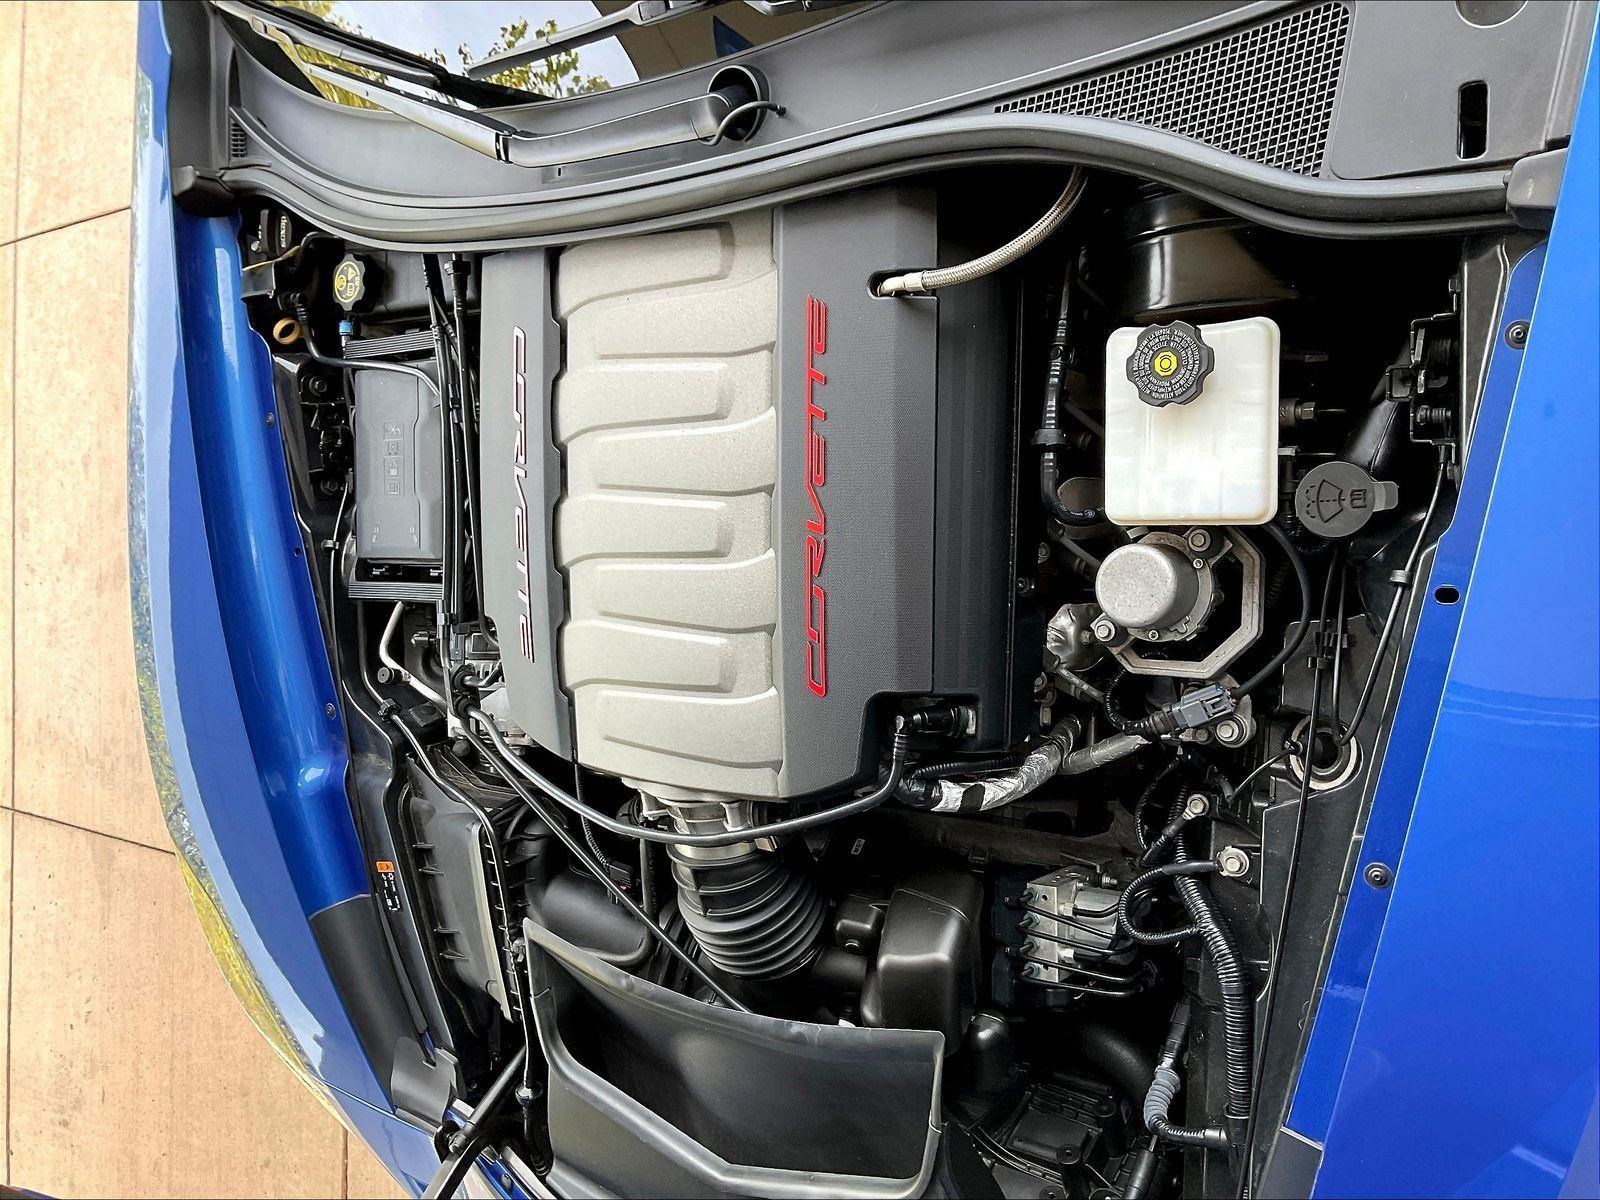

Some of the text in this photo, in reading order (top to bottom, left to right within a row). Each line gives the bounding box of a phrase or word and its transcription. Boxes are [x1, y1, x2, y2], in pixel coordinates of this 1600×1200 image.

[280, 215, 288, 248] dexos
[513, 326, 535, 664] CORVETTE
[805, 295, 828, 698] CORVETTE
